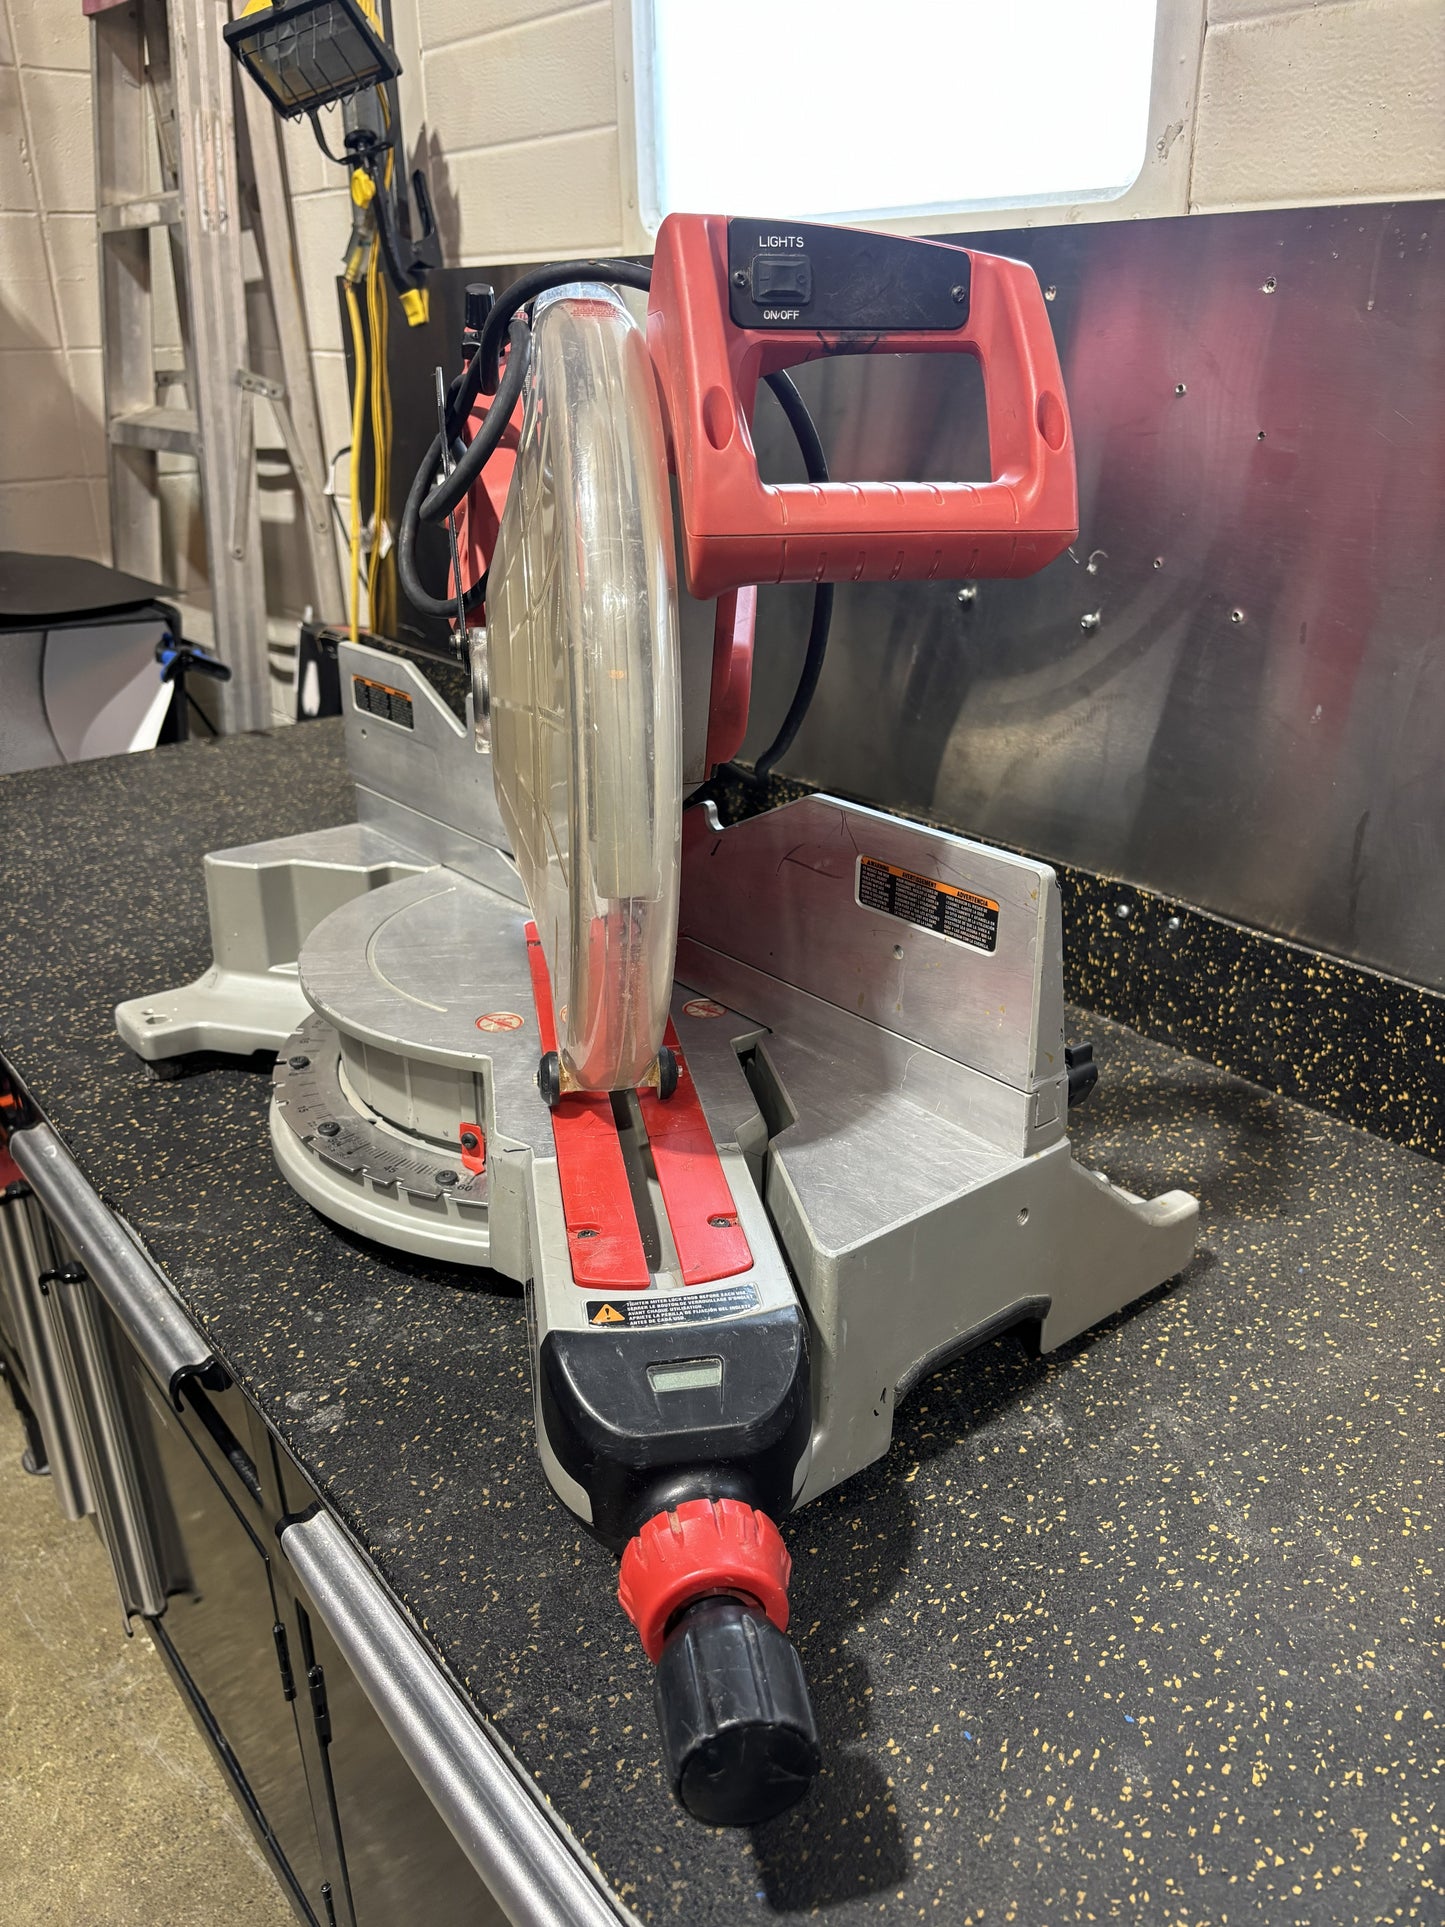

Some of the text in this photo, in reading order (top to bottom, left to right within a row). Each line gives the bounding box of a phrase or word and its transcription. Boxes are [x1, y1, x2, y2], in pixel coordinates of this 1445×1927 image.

[759, 235, 804, 248] LIGHTS
[763, 310, 800, 320] ON/OFF
[957, 891, 989, 907] ADVERTENCIA
[384, 1165, 398, 1173] 45
[458, 1183, 473, 1192] 60
